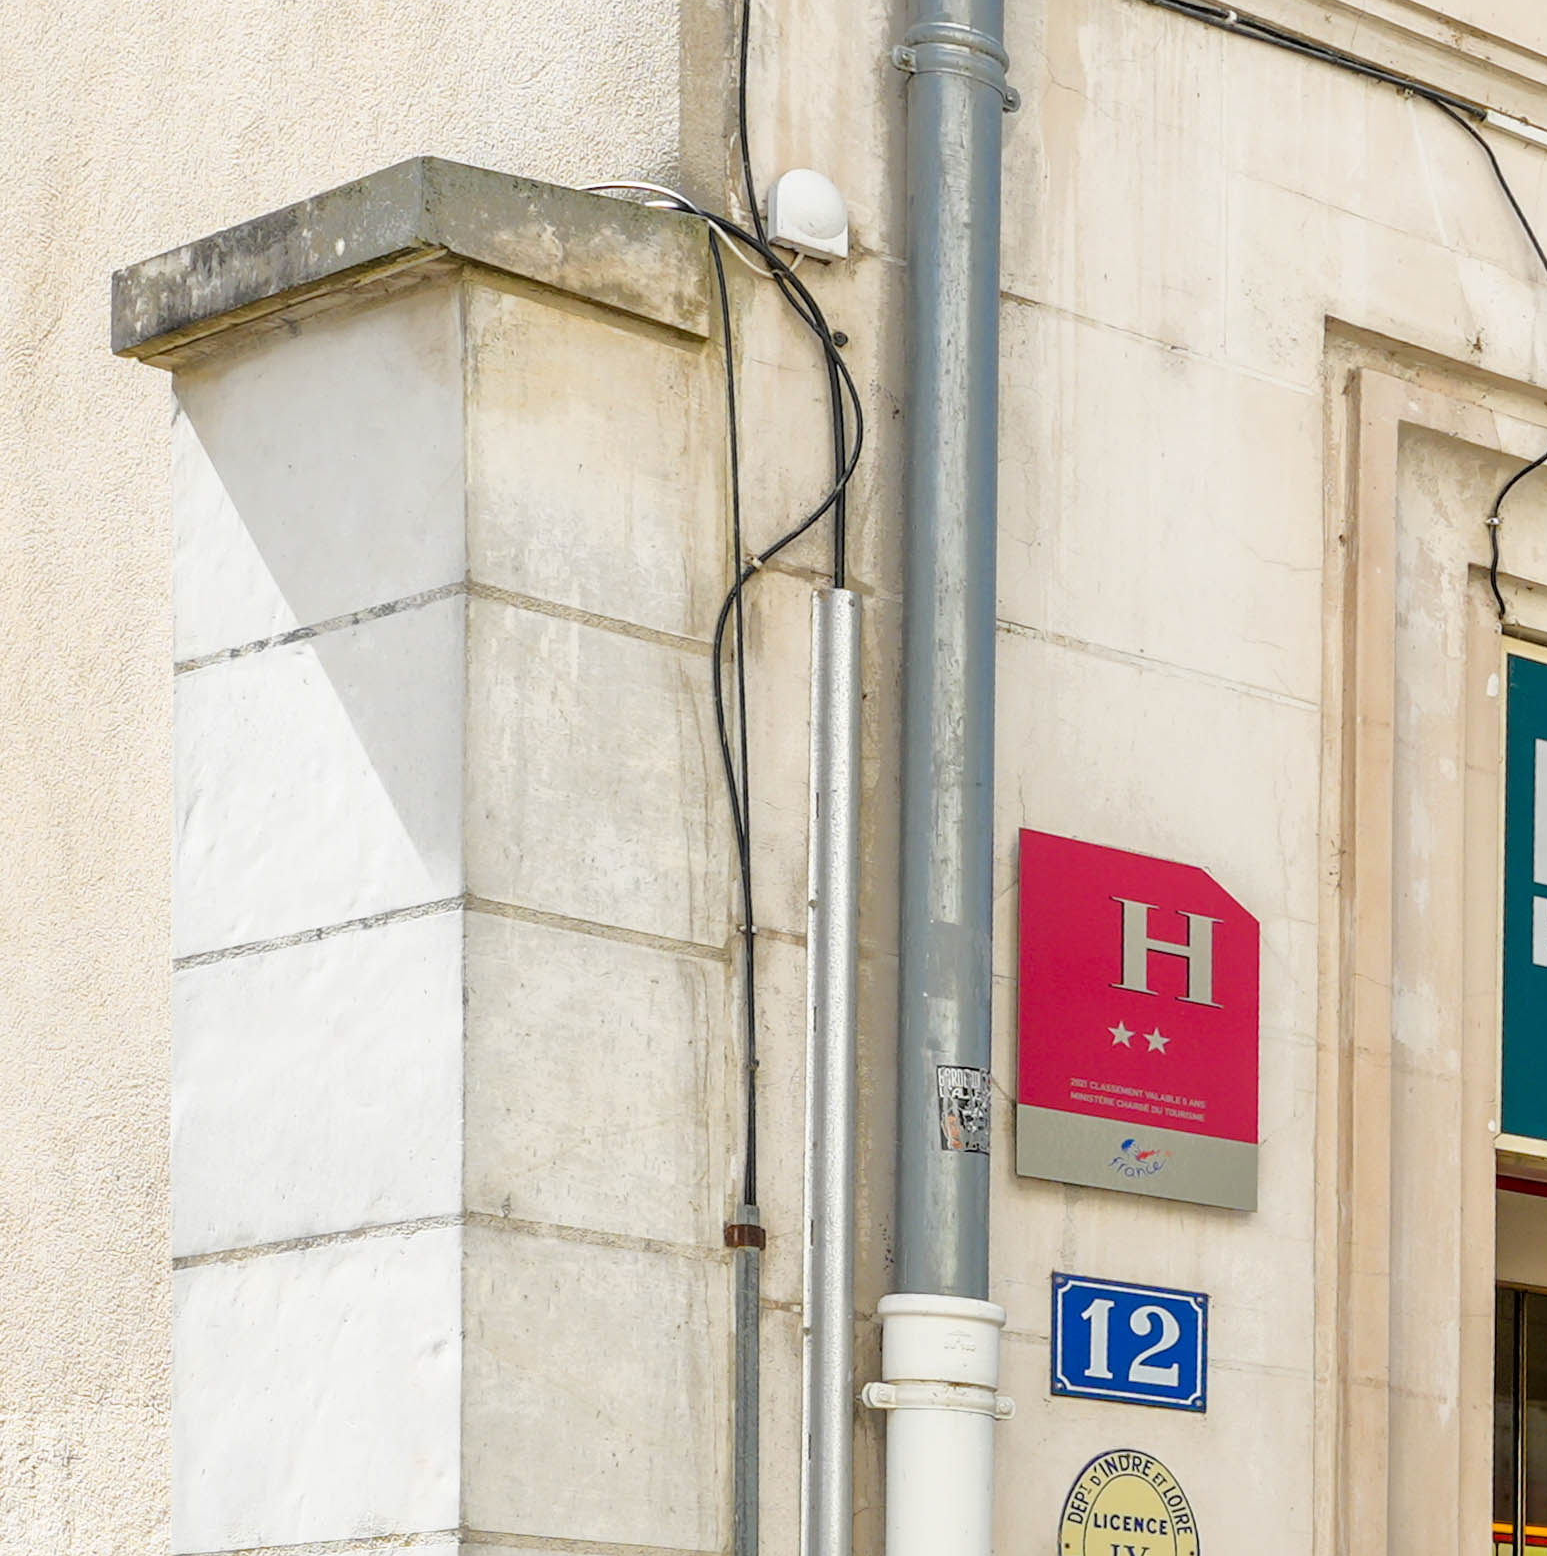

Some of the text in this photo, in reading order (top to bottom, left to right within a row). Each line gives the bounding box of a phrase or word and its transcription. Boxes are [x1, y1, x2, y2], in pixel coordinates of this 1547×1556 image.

[1108, 895, 1224, 1009] H
[1089, 1081, 1144, 1098] CLASSEMENT
[1164, 1108, 1205, 1122] TOURISME
[1081, 1298, 1180, 1387] 12
[1093, 1512, 1168, 1536] LICENCE
[1152, 1473, 1167, 1487] ET
[1163, 1486, 1193, 1535] LOIRE
